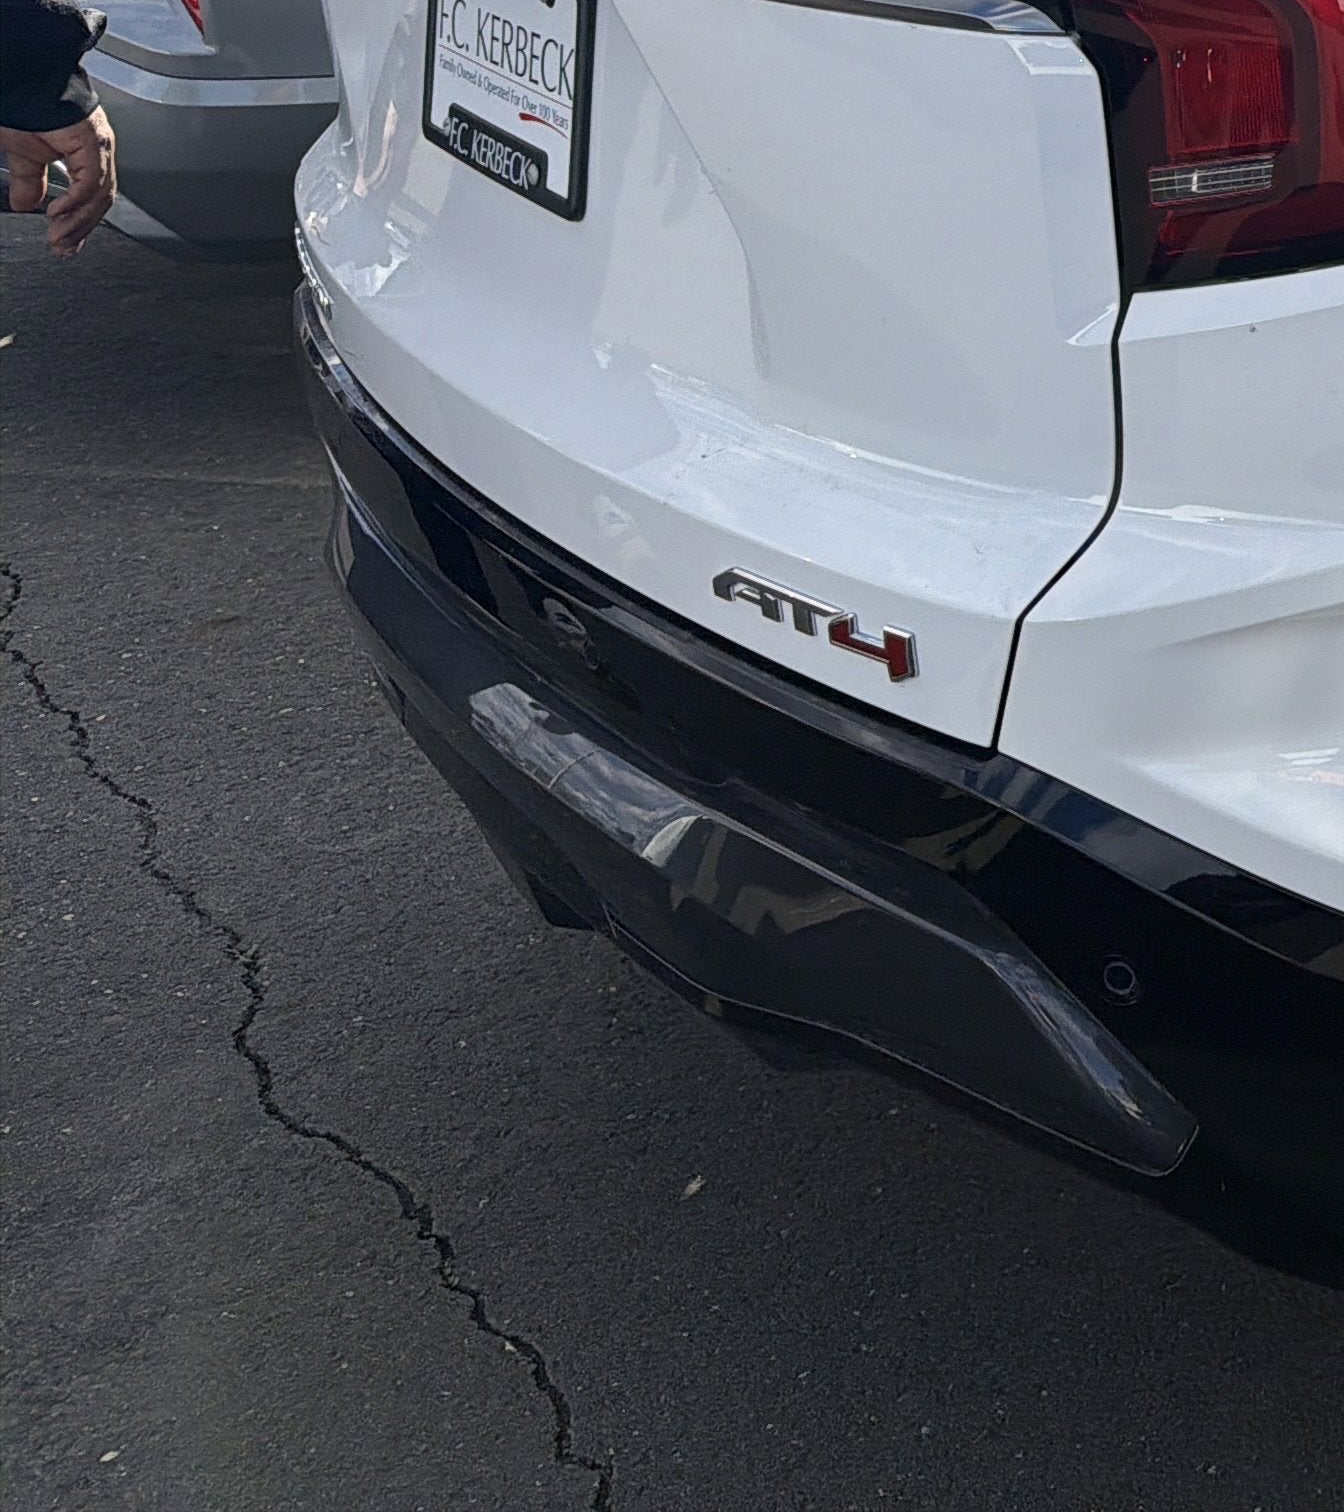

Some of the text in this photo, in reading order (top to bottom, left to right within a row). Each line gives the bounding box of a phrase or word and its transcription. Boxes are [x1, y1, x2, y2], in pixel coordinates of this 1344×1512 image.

[476, 7, 575, 100] KERBECK
[457, 62, 478, 86] Owned
[483, 76, 511, 104] Operated
[511, 88, 521, 106] For
[522, 95, 538, 114] Over
[551, 107, 569, 131] Years
[471, 129, 532, 190] KERBECK
[712, 566, 920, 683] AT4
